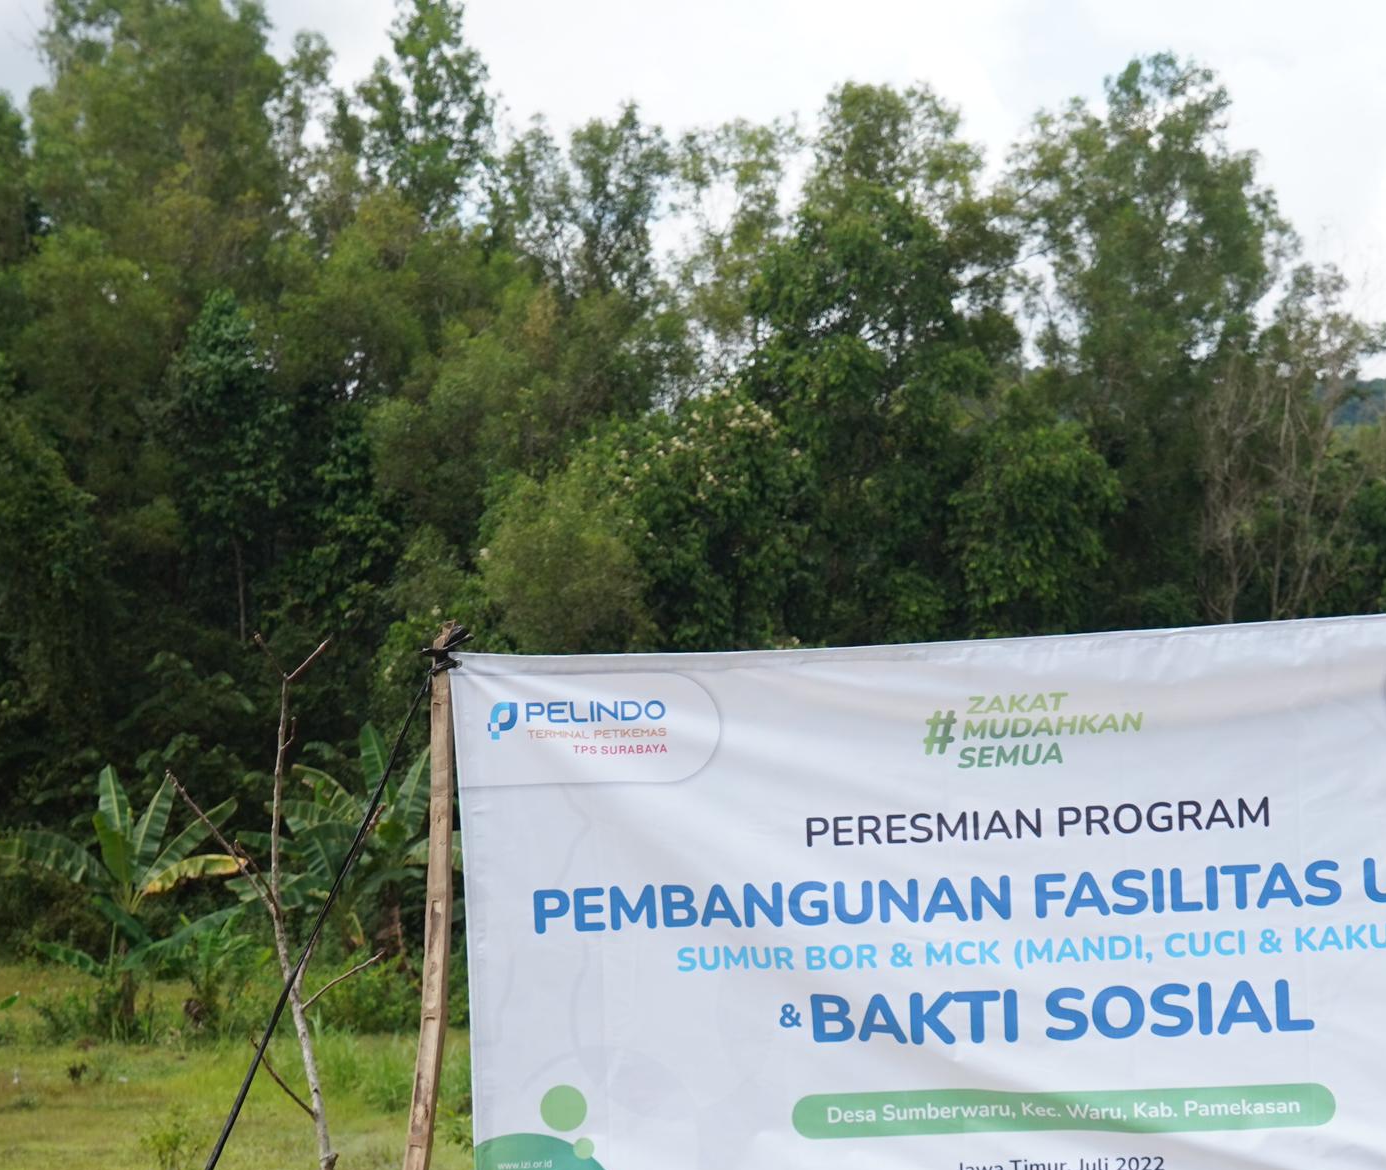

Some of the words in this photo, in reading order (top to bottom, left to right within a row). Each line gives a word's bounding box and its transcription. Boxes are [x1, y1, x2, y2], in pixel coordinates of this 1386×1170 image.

[525, 700, 666, 723] PELINDO
[966, 692, 1069, 714] ZAKAT
[527, 729, 589, 739] TERMINAL
[594, 727, 668, 739] PETIKEMAS
[962, 711, 1144, 740] MUDAHKAN
[573, 745, 597, 755] TPS
[601, 743, 668, 755] SURABAYA
[957, 742, 1063, 769] SEMUA
[806, 808, 1042, 848] PERESMIAN
[1058, 796, 1270, 838] PROGRAM
[533, 874, 1011, 935] PEMBANGUNAN
[1034, 860, 1342, 919] FASILITAS
[676, 946, 794, 972] SUMUR
[805, 943, 877, 970] BOR
[890, 942, 913, 968] &
[924, 939, 1001, 967] MCK
[1013, 934, 1153, 969] (MANDI,
[1164, 929, 1246, 959] CUCI
[1258, 928, 1283, 954] &
[779, 1003, 803, 1029] &
[810, 988, 1019, 1046] BAKTI
[1045, 979, 1316, 1041] SOSIAL
[827, 1106, 877, 1124] Desa
[882, 1102, 1016, 1122] Sumberwaru,
[1021, 1101, 1062, 1118] Kec.
[1065, 1102, 1128, 1122] Waru,
[1133, 1101, 1178, 1119] Kab.
[1184, 1099, 1301, 1118] Pamekasan
